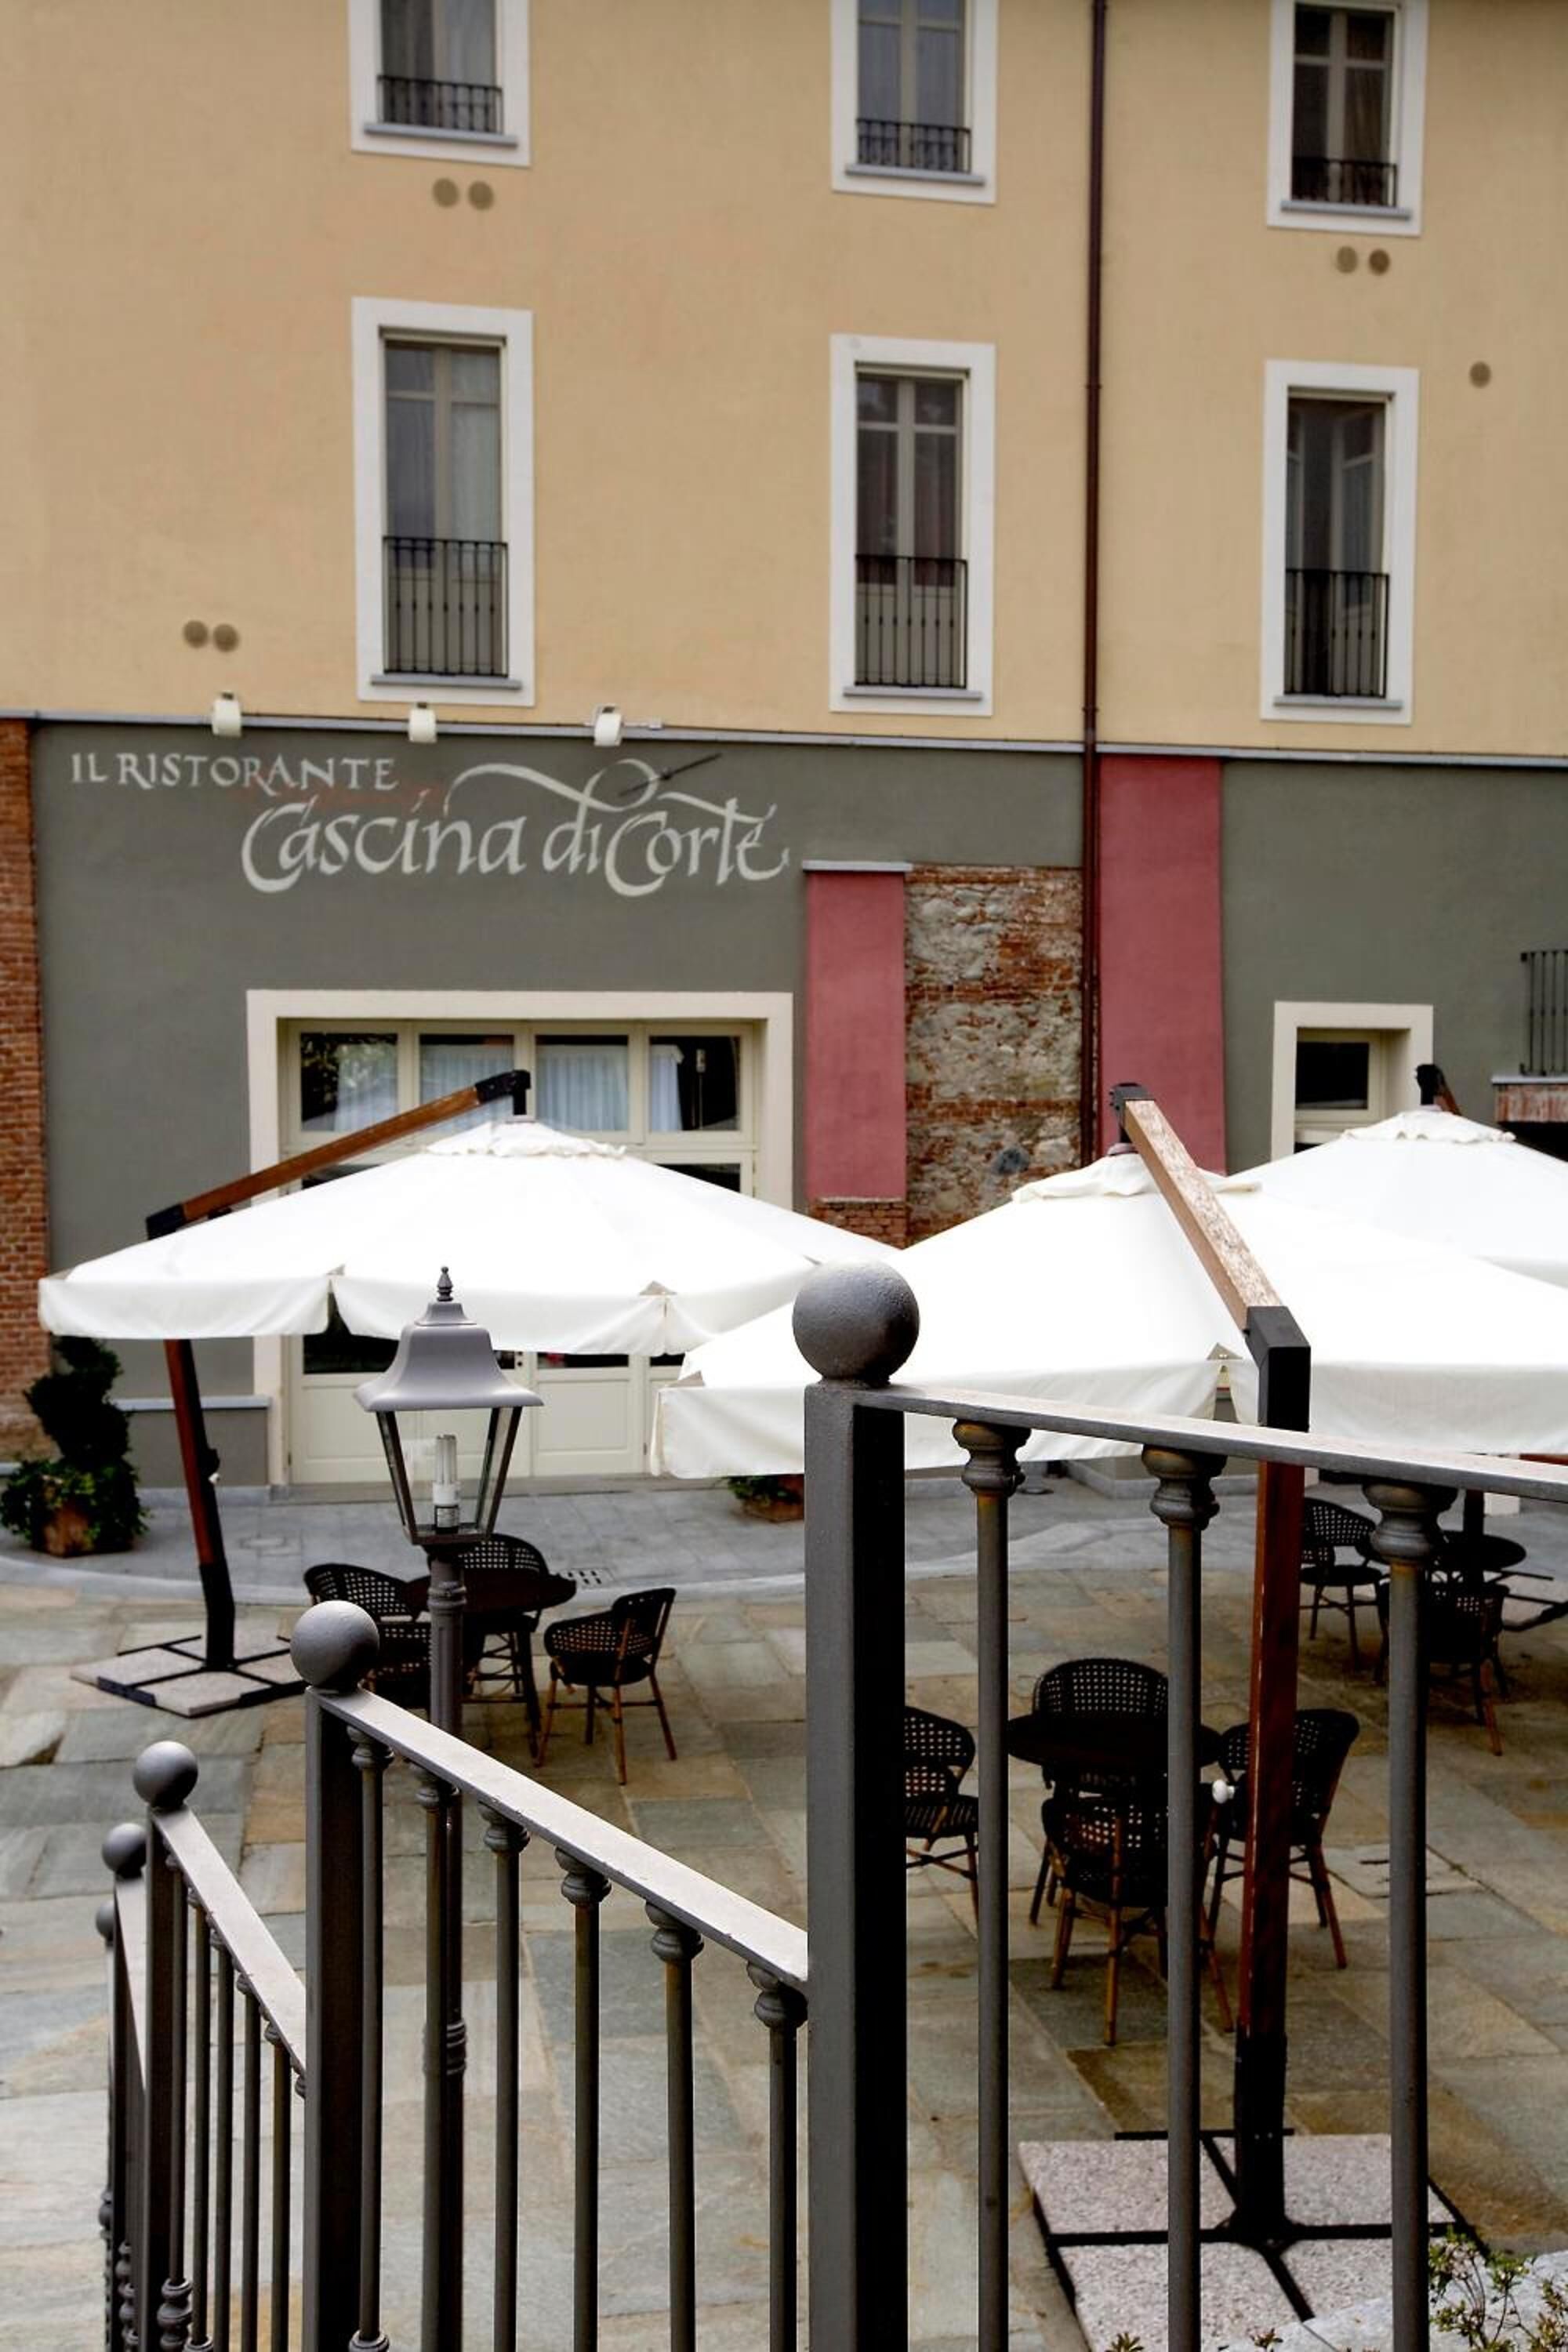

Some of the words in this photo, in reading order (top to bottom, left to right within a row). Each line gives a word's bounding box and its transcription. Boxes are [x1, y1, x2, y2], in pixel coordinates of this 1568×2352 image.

[72, 753, 108, 782] IL
[116, 753, 399, 796] RISTORANTE
[241, 788, 527, 892] Cascina
[604, 792, 789, 896] Corte
